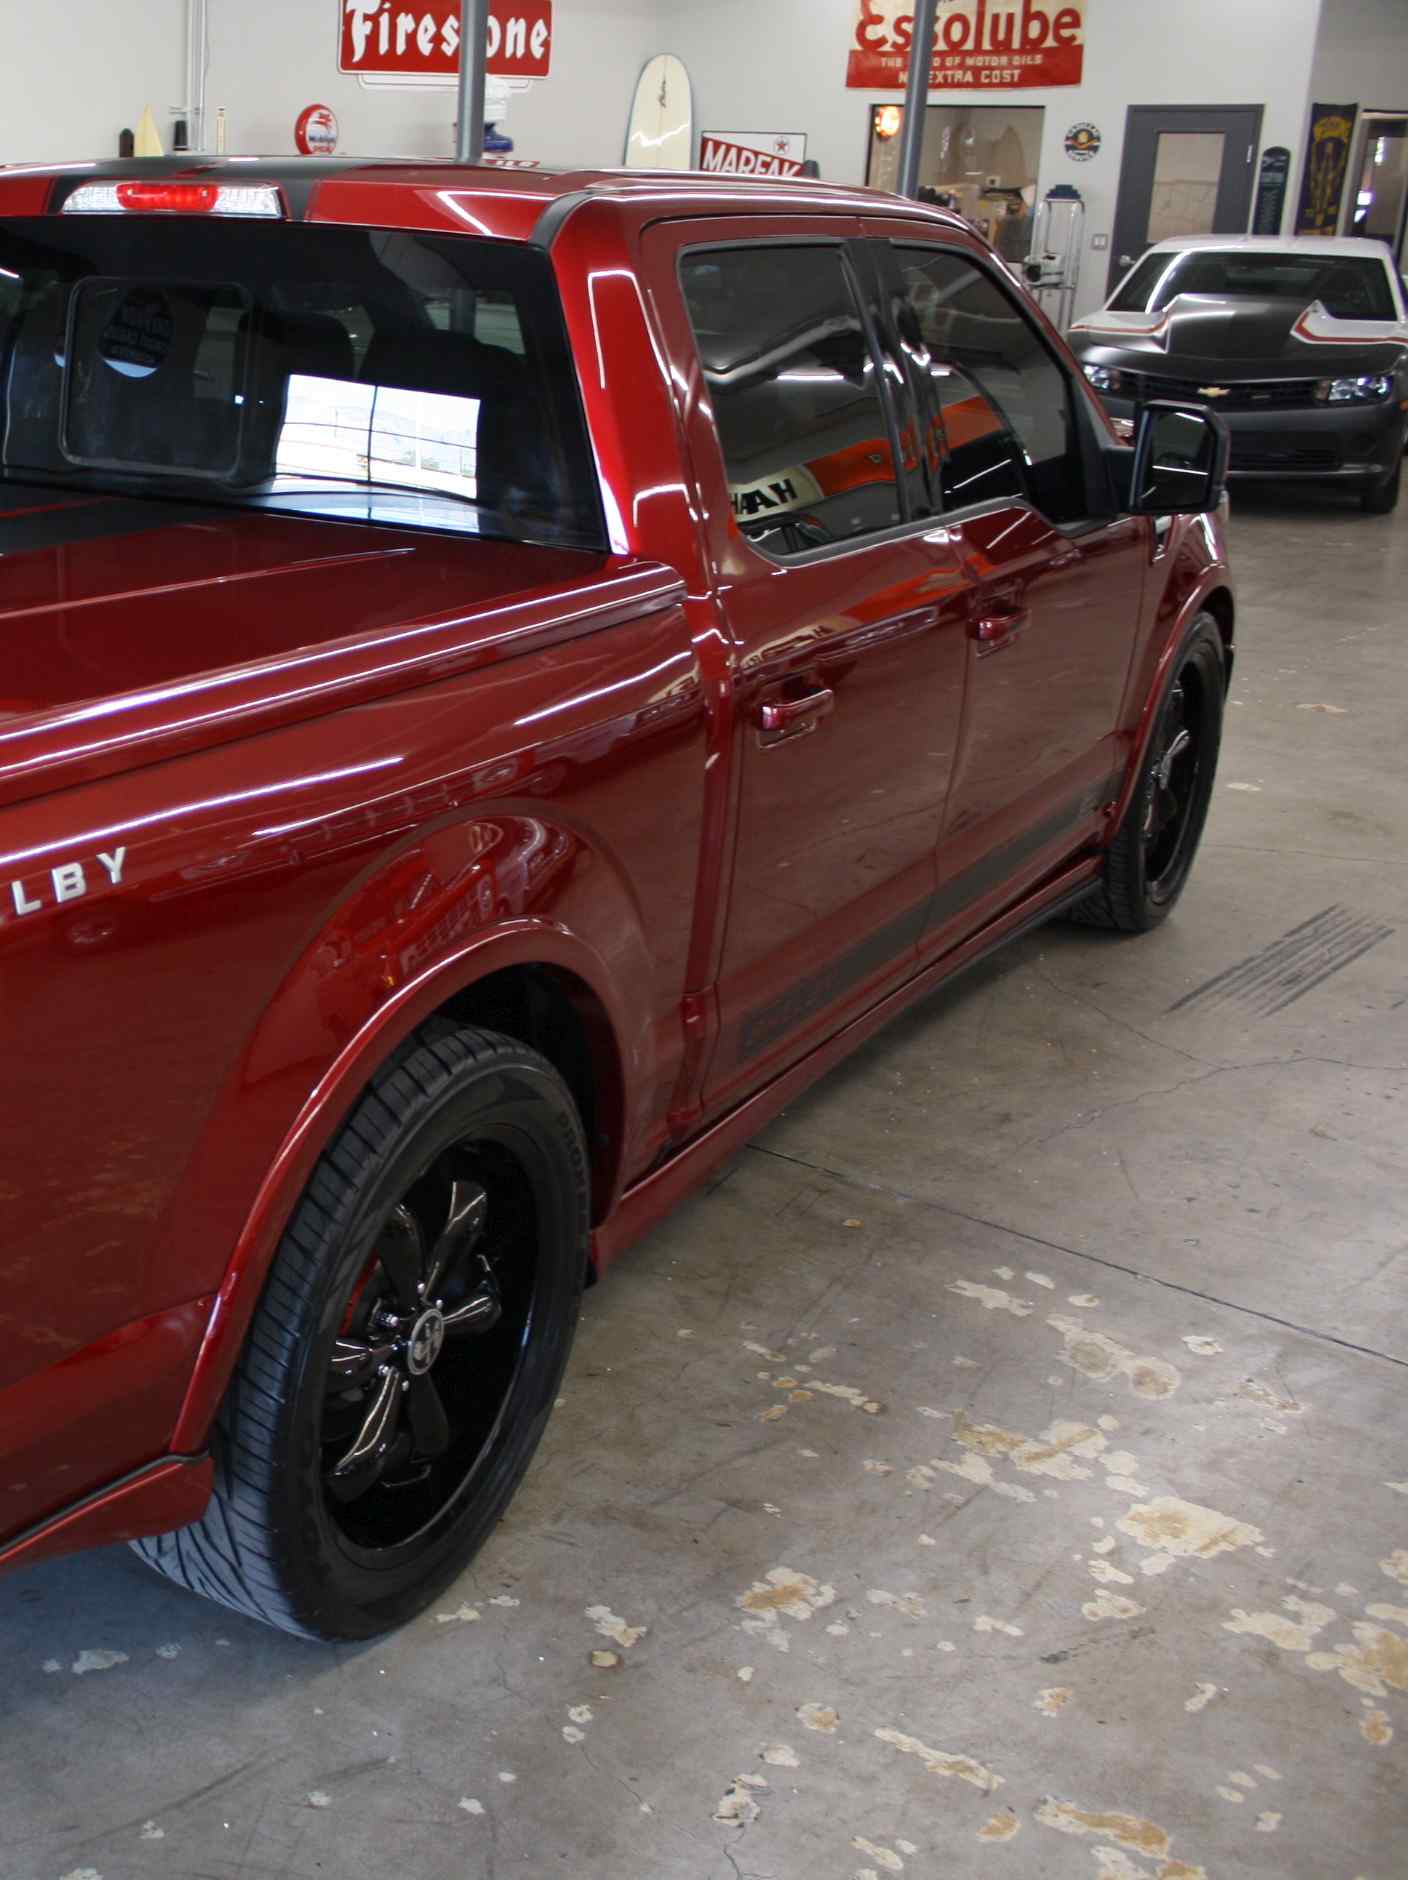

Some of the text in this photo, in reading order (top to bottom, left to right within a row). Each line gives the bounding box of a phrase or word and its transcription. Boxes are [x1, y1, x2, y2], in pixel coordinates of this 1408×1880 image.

[346, 0, 548, 62] Firesone
[855, 0, 1081, 50] Esolube
[945, 56, 961, 66] OF
[965, 56, 1008, 67] MOTOR
[1012, 54, 1043, 65] OILS
[980, 69, 1022, 84] COST
